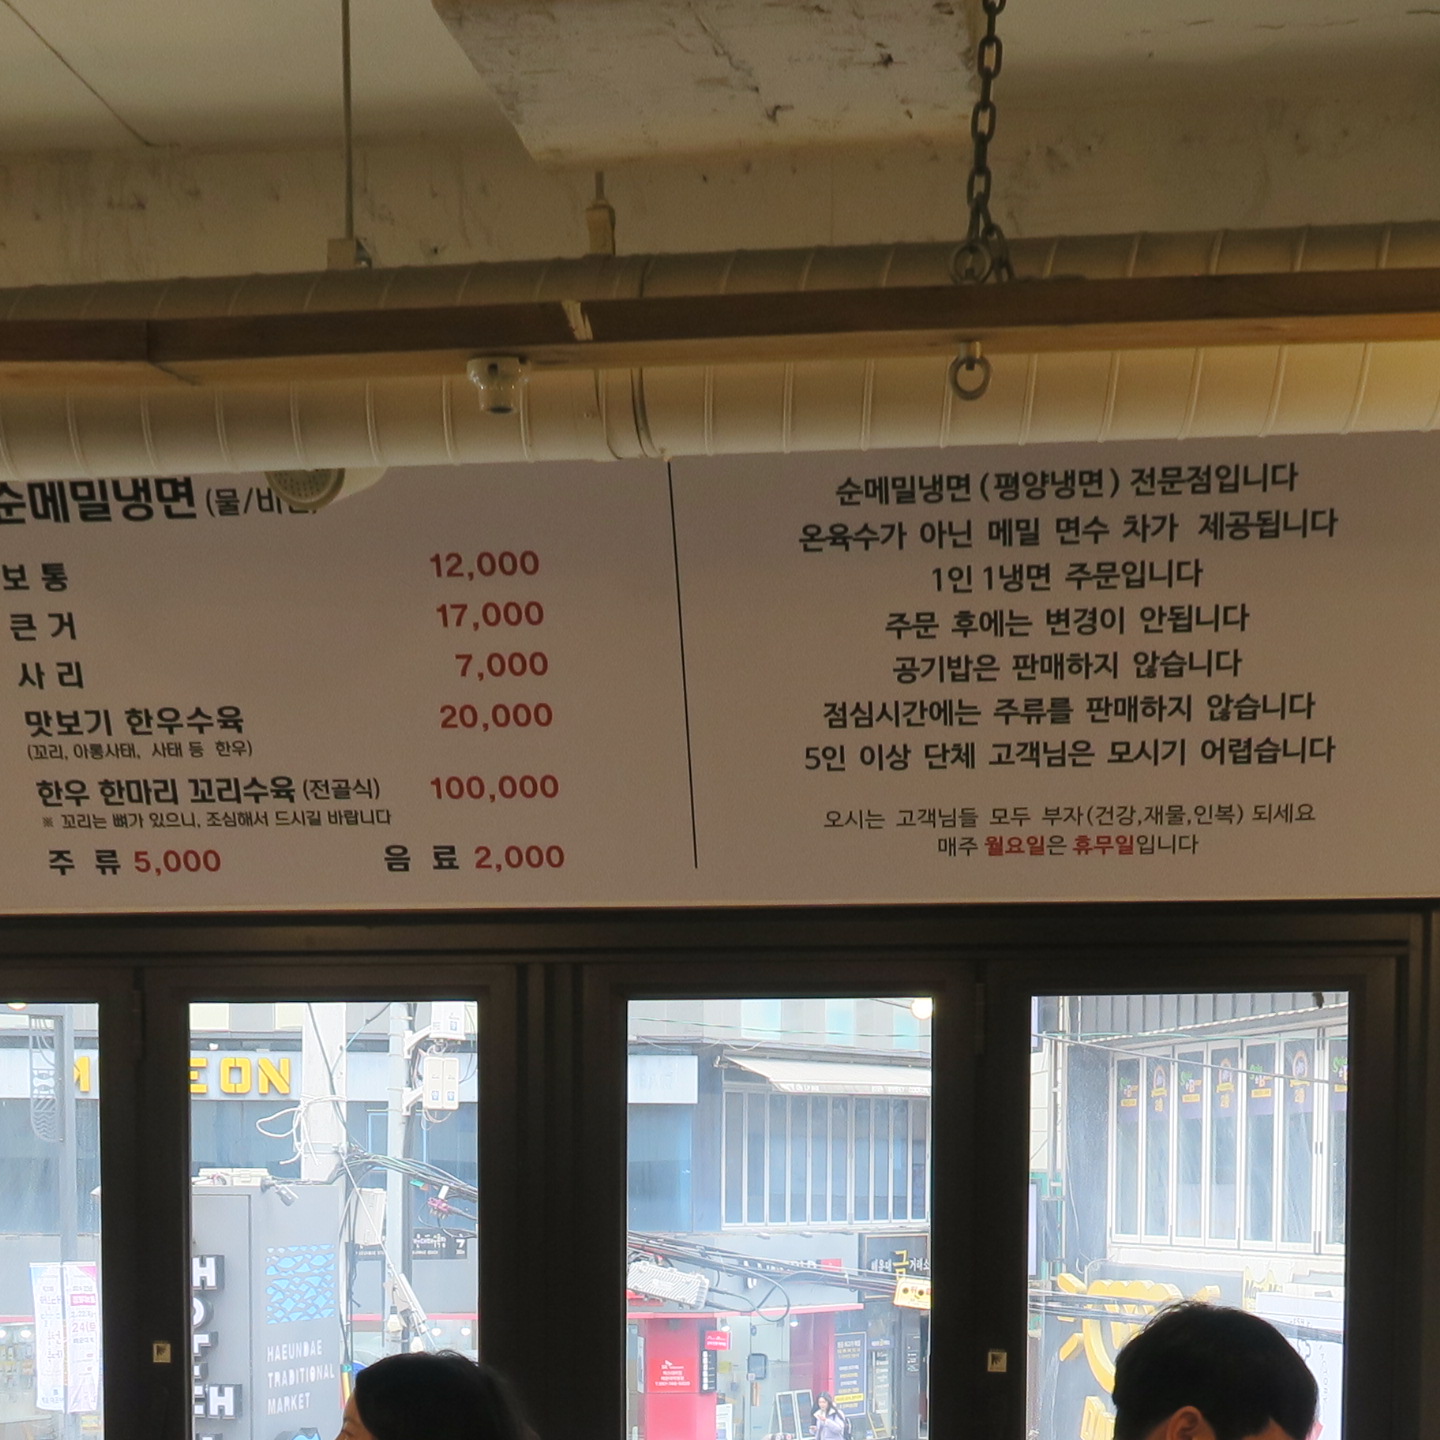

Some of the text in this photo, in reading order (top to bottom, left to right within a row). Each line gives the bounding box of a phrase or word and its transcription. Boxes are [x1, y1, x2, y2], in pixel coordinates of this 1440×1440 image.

[836, 462, 1298, 506] 순메밀냉면 (평양냉면) 전문점입니다
[206, 487, 318, 517] (물/비
[799, 508, 1338, 552] 온육수가 아닌 메밀 면수 차가 제공됩니다
[430, 551, 539, 581] 12,000
[933, 559, 1203, 593] 1인 1냉면 주문입니다
[437, 601, 543, 631] 17,000
[886, 603, 1249, 640] 주문 후에는 변경이 안됩니다
[455, 652, 548, 681] 7,000
[893, 648, 1242, 684] 공기밥은 판매하지 않습니다
[25, 706, 243, 737] 맛보기 한우수육
[440, 703, 552, 731] 20,000
[824, 692, 1315, 729] 점심시간에는 주류를 판매하지 않습니다
[152, 742, 183, 758] 사태
[189, 742, 203, 758] 등
[215, 740, 252, 757] 한우)
[805, 736, 1336, 772] 5인 이상 단체 고객님은 모시기 어렵습니다
[36, 776, 380, 807] 한우 한마리 꼬리수육 (전골식)
[431, 775, 558, 803] 100,000
[207, 811, 269, 827] 조심해서
[275, 810, 321, 826] 드시길
[328, 809, 391, 826] 바랍니다
[824, 809, 885, 829] 오시는
[897, 808, 978, 828] 고객님들
[990, 807, 1030, 827] 모두
[1253, 803, 1315, 824] 되세요
[475, 845, 564, 872] 2,000
[938, 834, 1198, 856] 매주 월요일은 휴무일입니다
[135, 849, 221, 876] 5,000
[267, 1340, 322, 1362] HAEUNDAE
[267, 1365, 335, 1389] TRADITIONAL
[267, 1392, 310, 1415] MARKET
